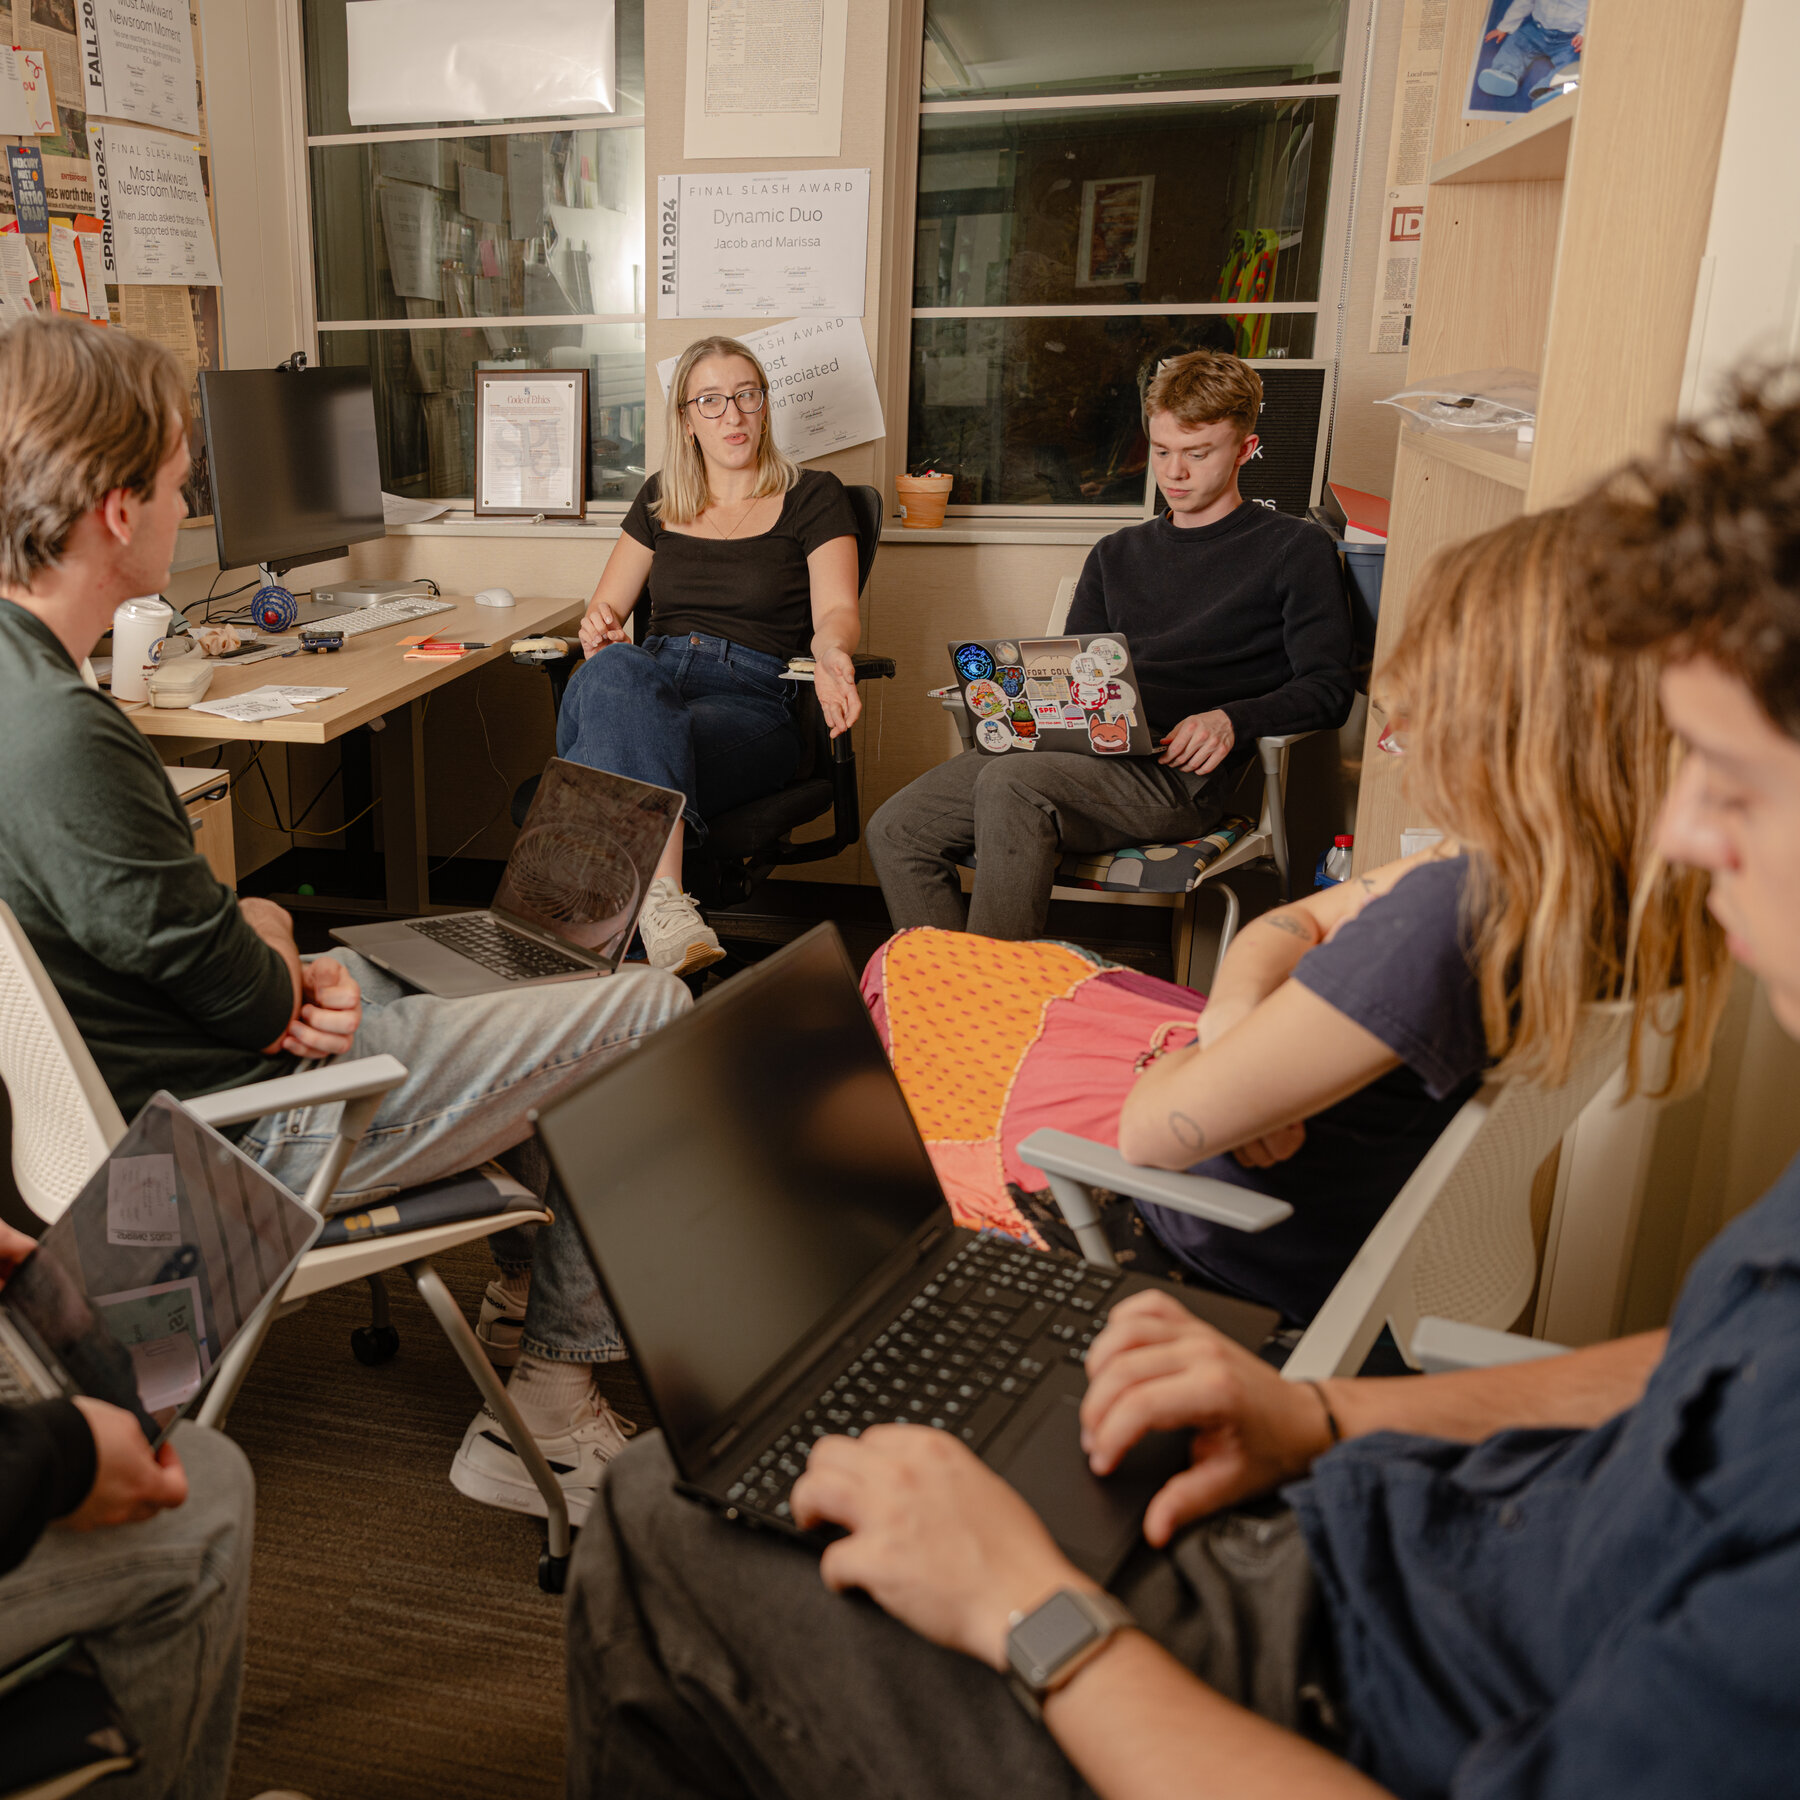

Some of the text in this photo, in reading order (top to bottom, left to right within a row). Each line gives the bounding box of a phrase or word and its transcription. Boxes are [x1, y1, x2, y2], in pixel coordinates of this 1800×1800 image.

[109, 9, 181, 42] Newsroom Moment
[86, 34, 102, 87] FALL
[112, 142, 141, 156] FINAL
[146, 147, 171, 160] SLASH
[174, 154, 194, 165] AWARD
[12, 157, 39, 169] MERCURY
[61, 173, 87, 182] ENTERPRISE
[129, 165, 188, 187] Most Awkward
[19, 189, 43, 205] RETRO
[59, 187, 80, 202] worth
[81, 189, 92, 202] the
[118, 180, 198, 202] Newsroom Moment
[690, 182, 853, 197] FINAL SLASH AWARD
[94, 137, 115, 271] SPRING 2024
[117, 209, 136, 221] When
[137, 211, 158, 222] Jacob
[159, 213, 176, 225] asked
[713, 207, 823, 227] Dynamic Duo
[134, 226, 169, 237] supported
[170, 226, 179, 236] the
[662, 198, 677, 295] FALL 2024
[714, 236, 821, 249] Jacob and Marissa
[793, 318, 844, 341] AWARD
[507, 395, 524, 404] Code
[532, 395, 551, 404] Ethics
[788, 390, 814, 405] Tory
